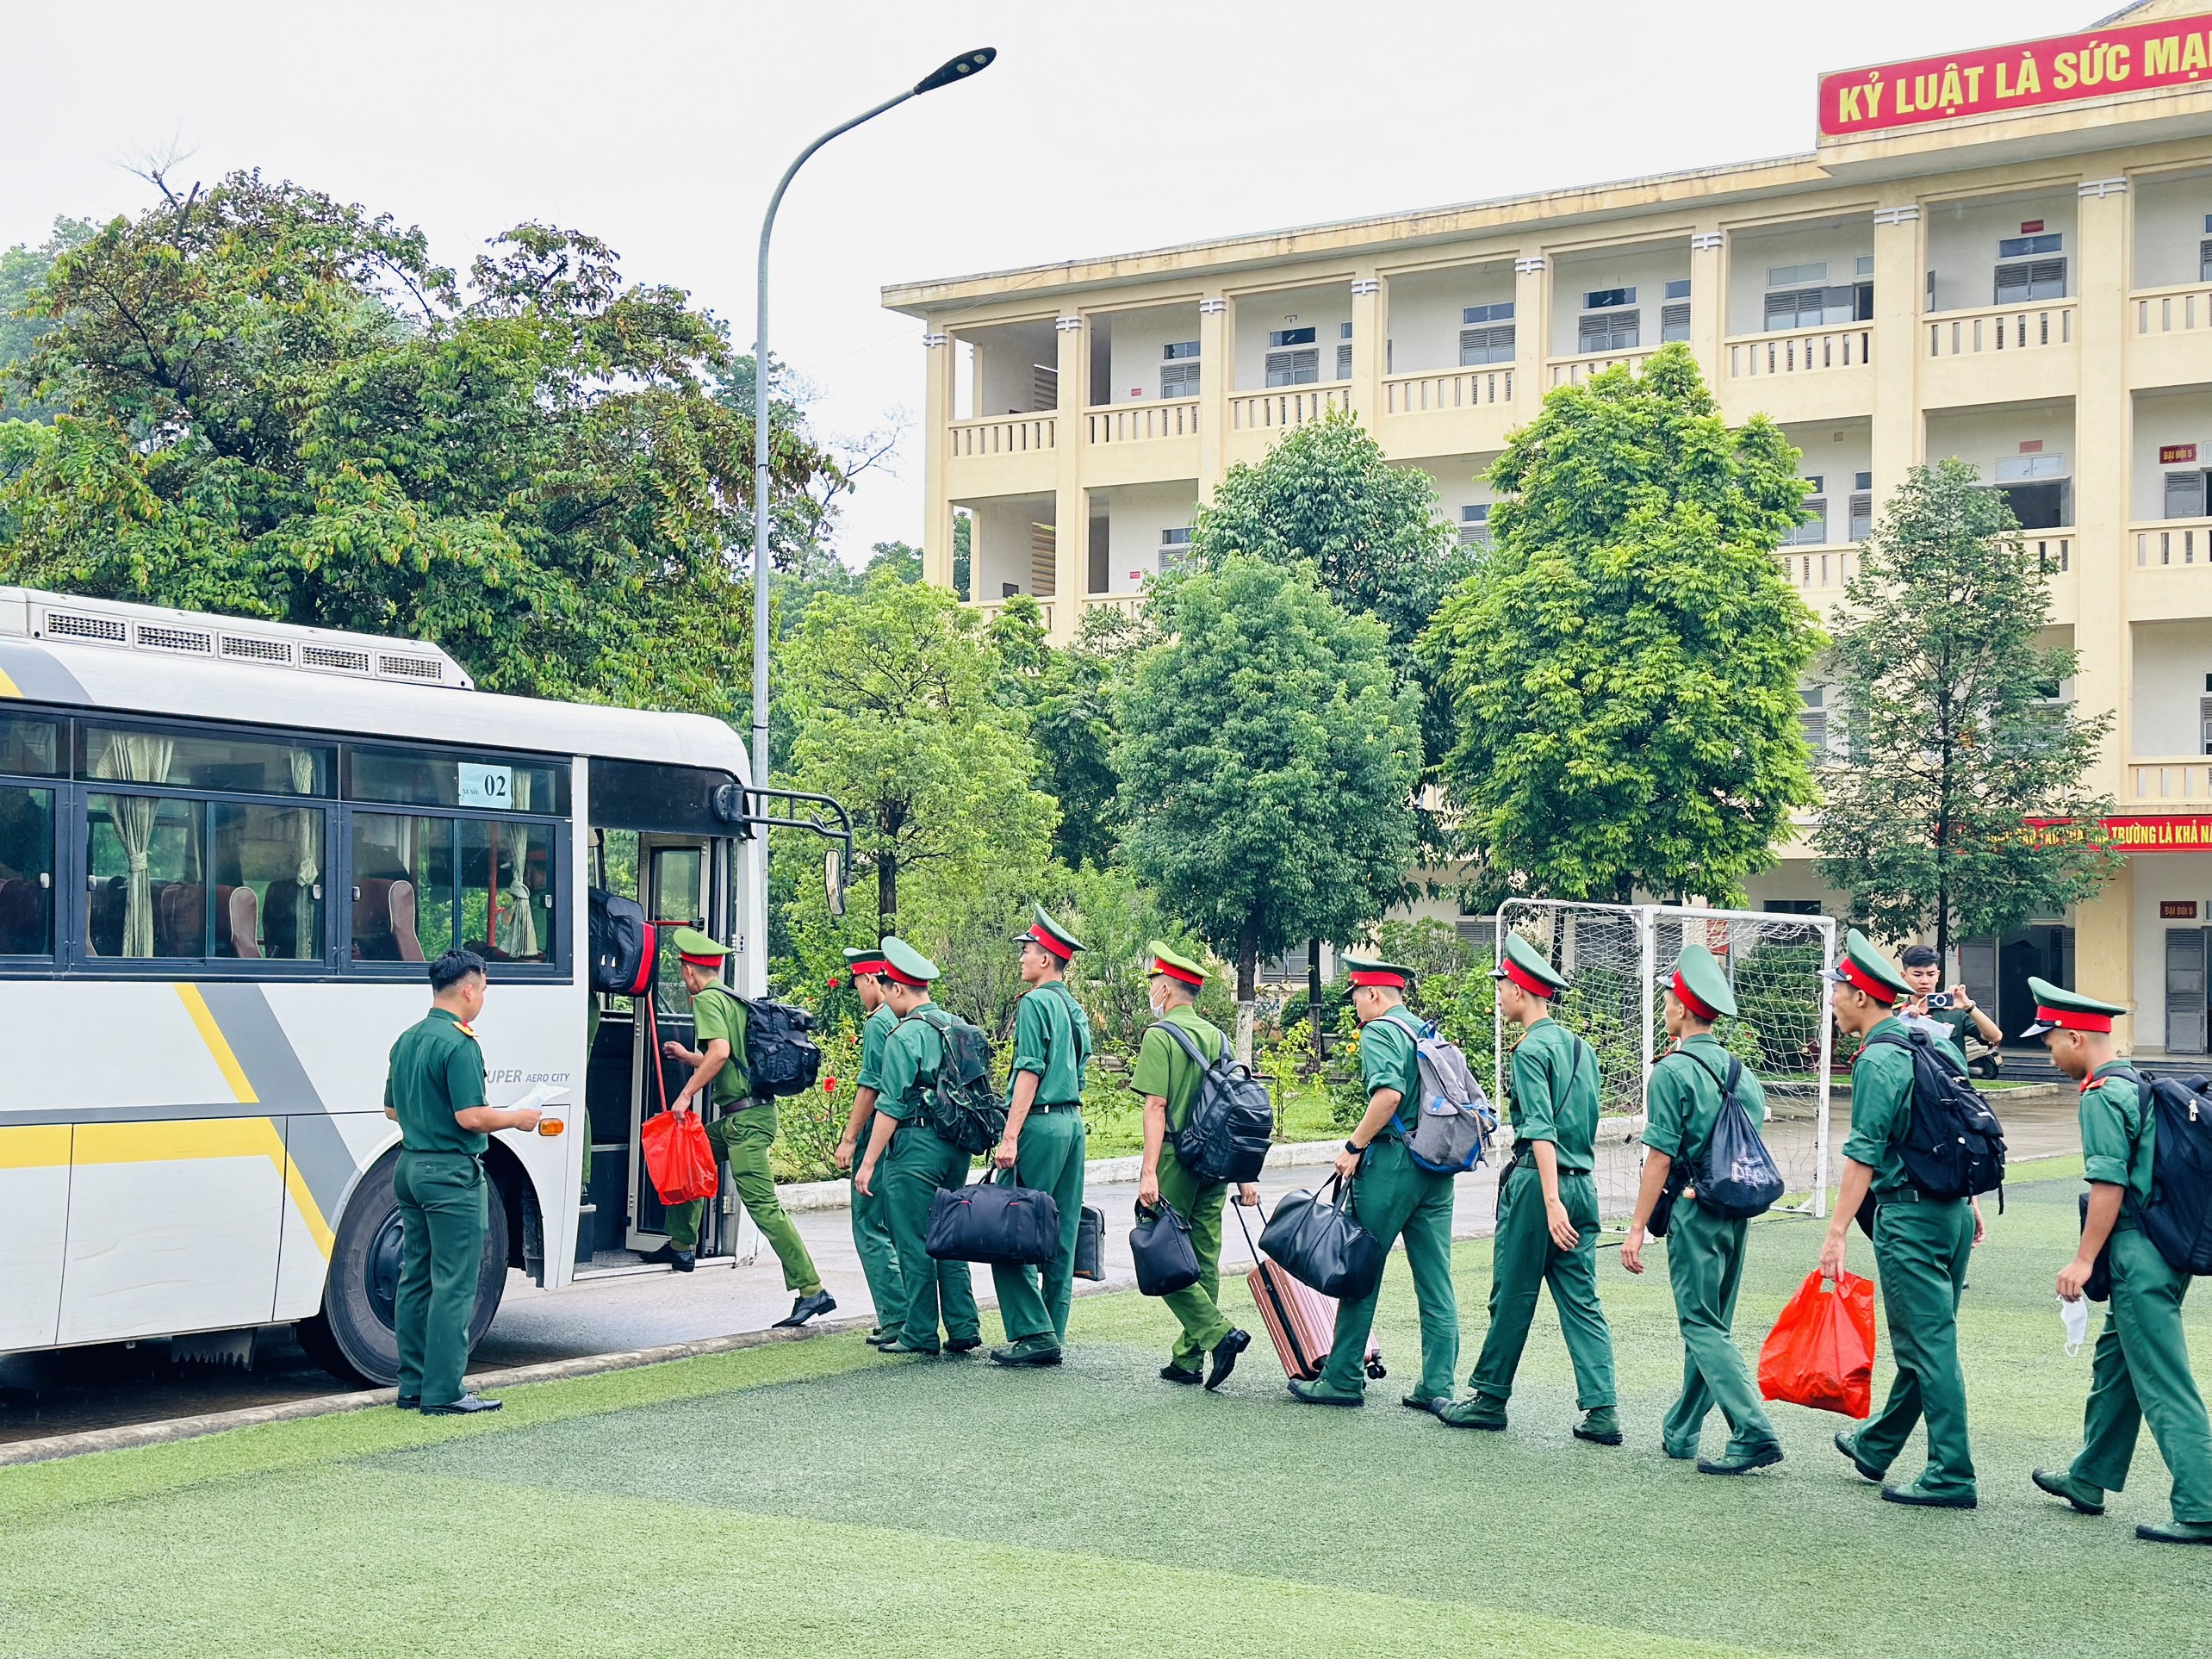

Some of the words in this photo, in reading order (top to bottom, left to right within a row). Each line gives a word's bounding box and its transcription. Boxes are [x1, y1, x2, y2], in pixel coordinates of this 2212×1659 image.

[1839, 71, 1885, 123] KỶ
[1896, 62, 1985, 115] LUẬT
[1996, 50, 2041, 99] LÀ
[2054, 40, 2130, 90] SỨC
[2144, 30, 2212, 78] MẠ
[484, 774, 506, 797] 02
[2111, 822, 2156, 844] TRƯỜNG
[2175, 819, 2198, 843] KHẢ
[487, 1069, 523, 1084] UPER
[525, 1073, 549, 1083] AERO
[551, 1073, 570, 1082] CITY
